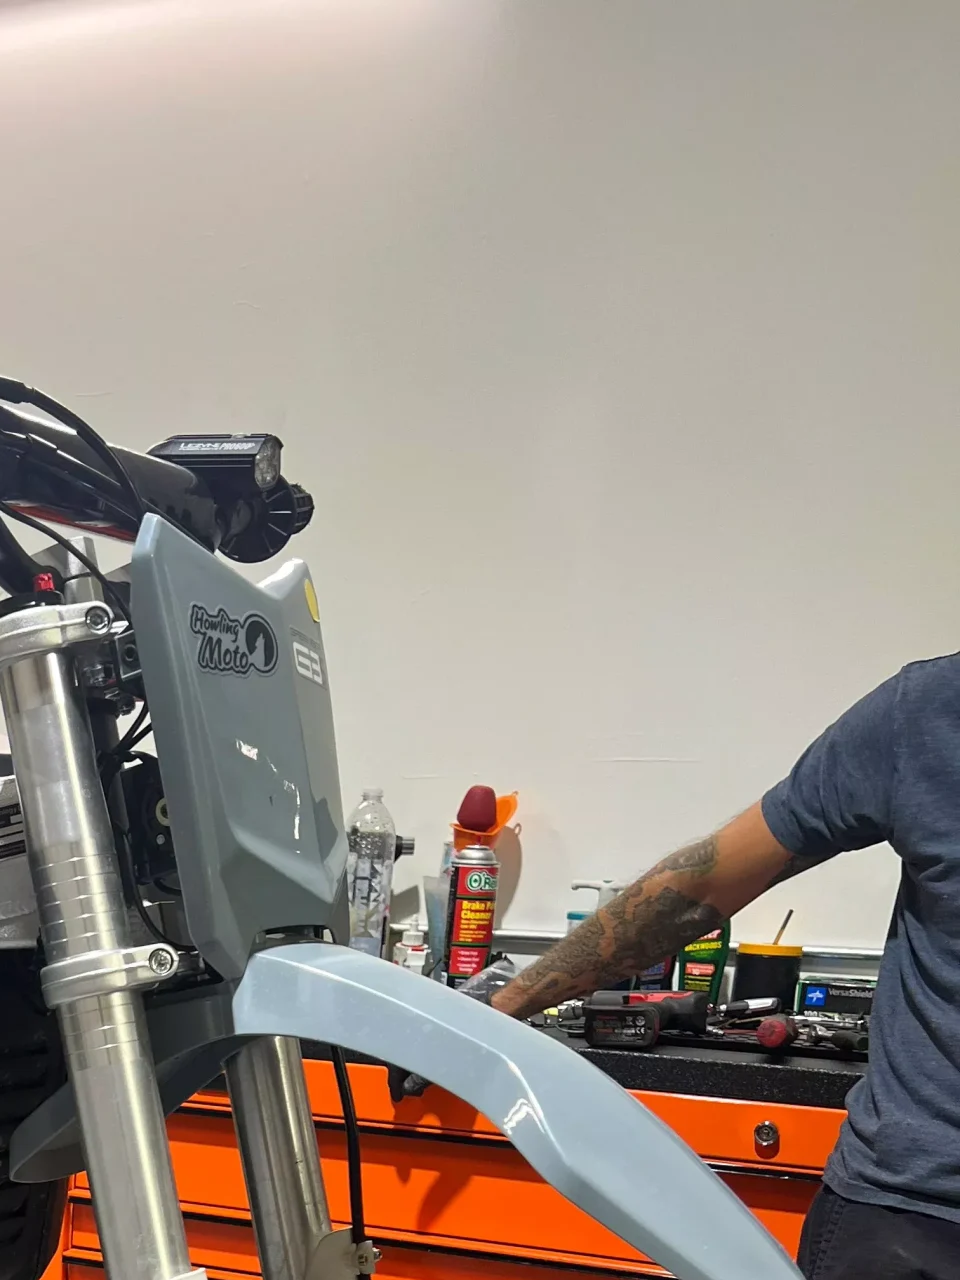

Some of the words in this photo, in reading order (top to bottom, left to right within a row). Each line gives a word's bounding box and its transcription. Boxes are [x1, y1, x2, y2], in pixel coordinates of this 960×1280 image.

[193, 606, 240, 643] Howling
[200, 635, 250, 671] Moto
[462, 900, 485, 911] Brake
[827, 987, 873, 998] VersaShield
